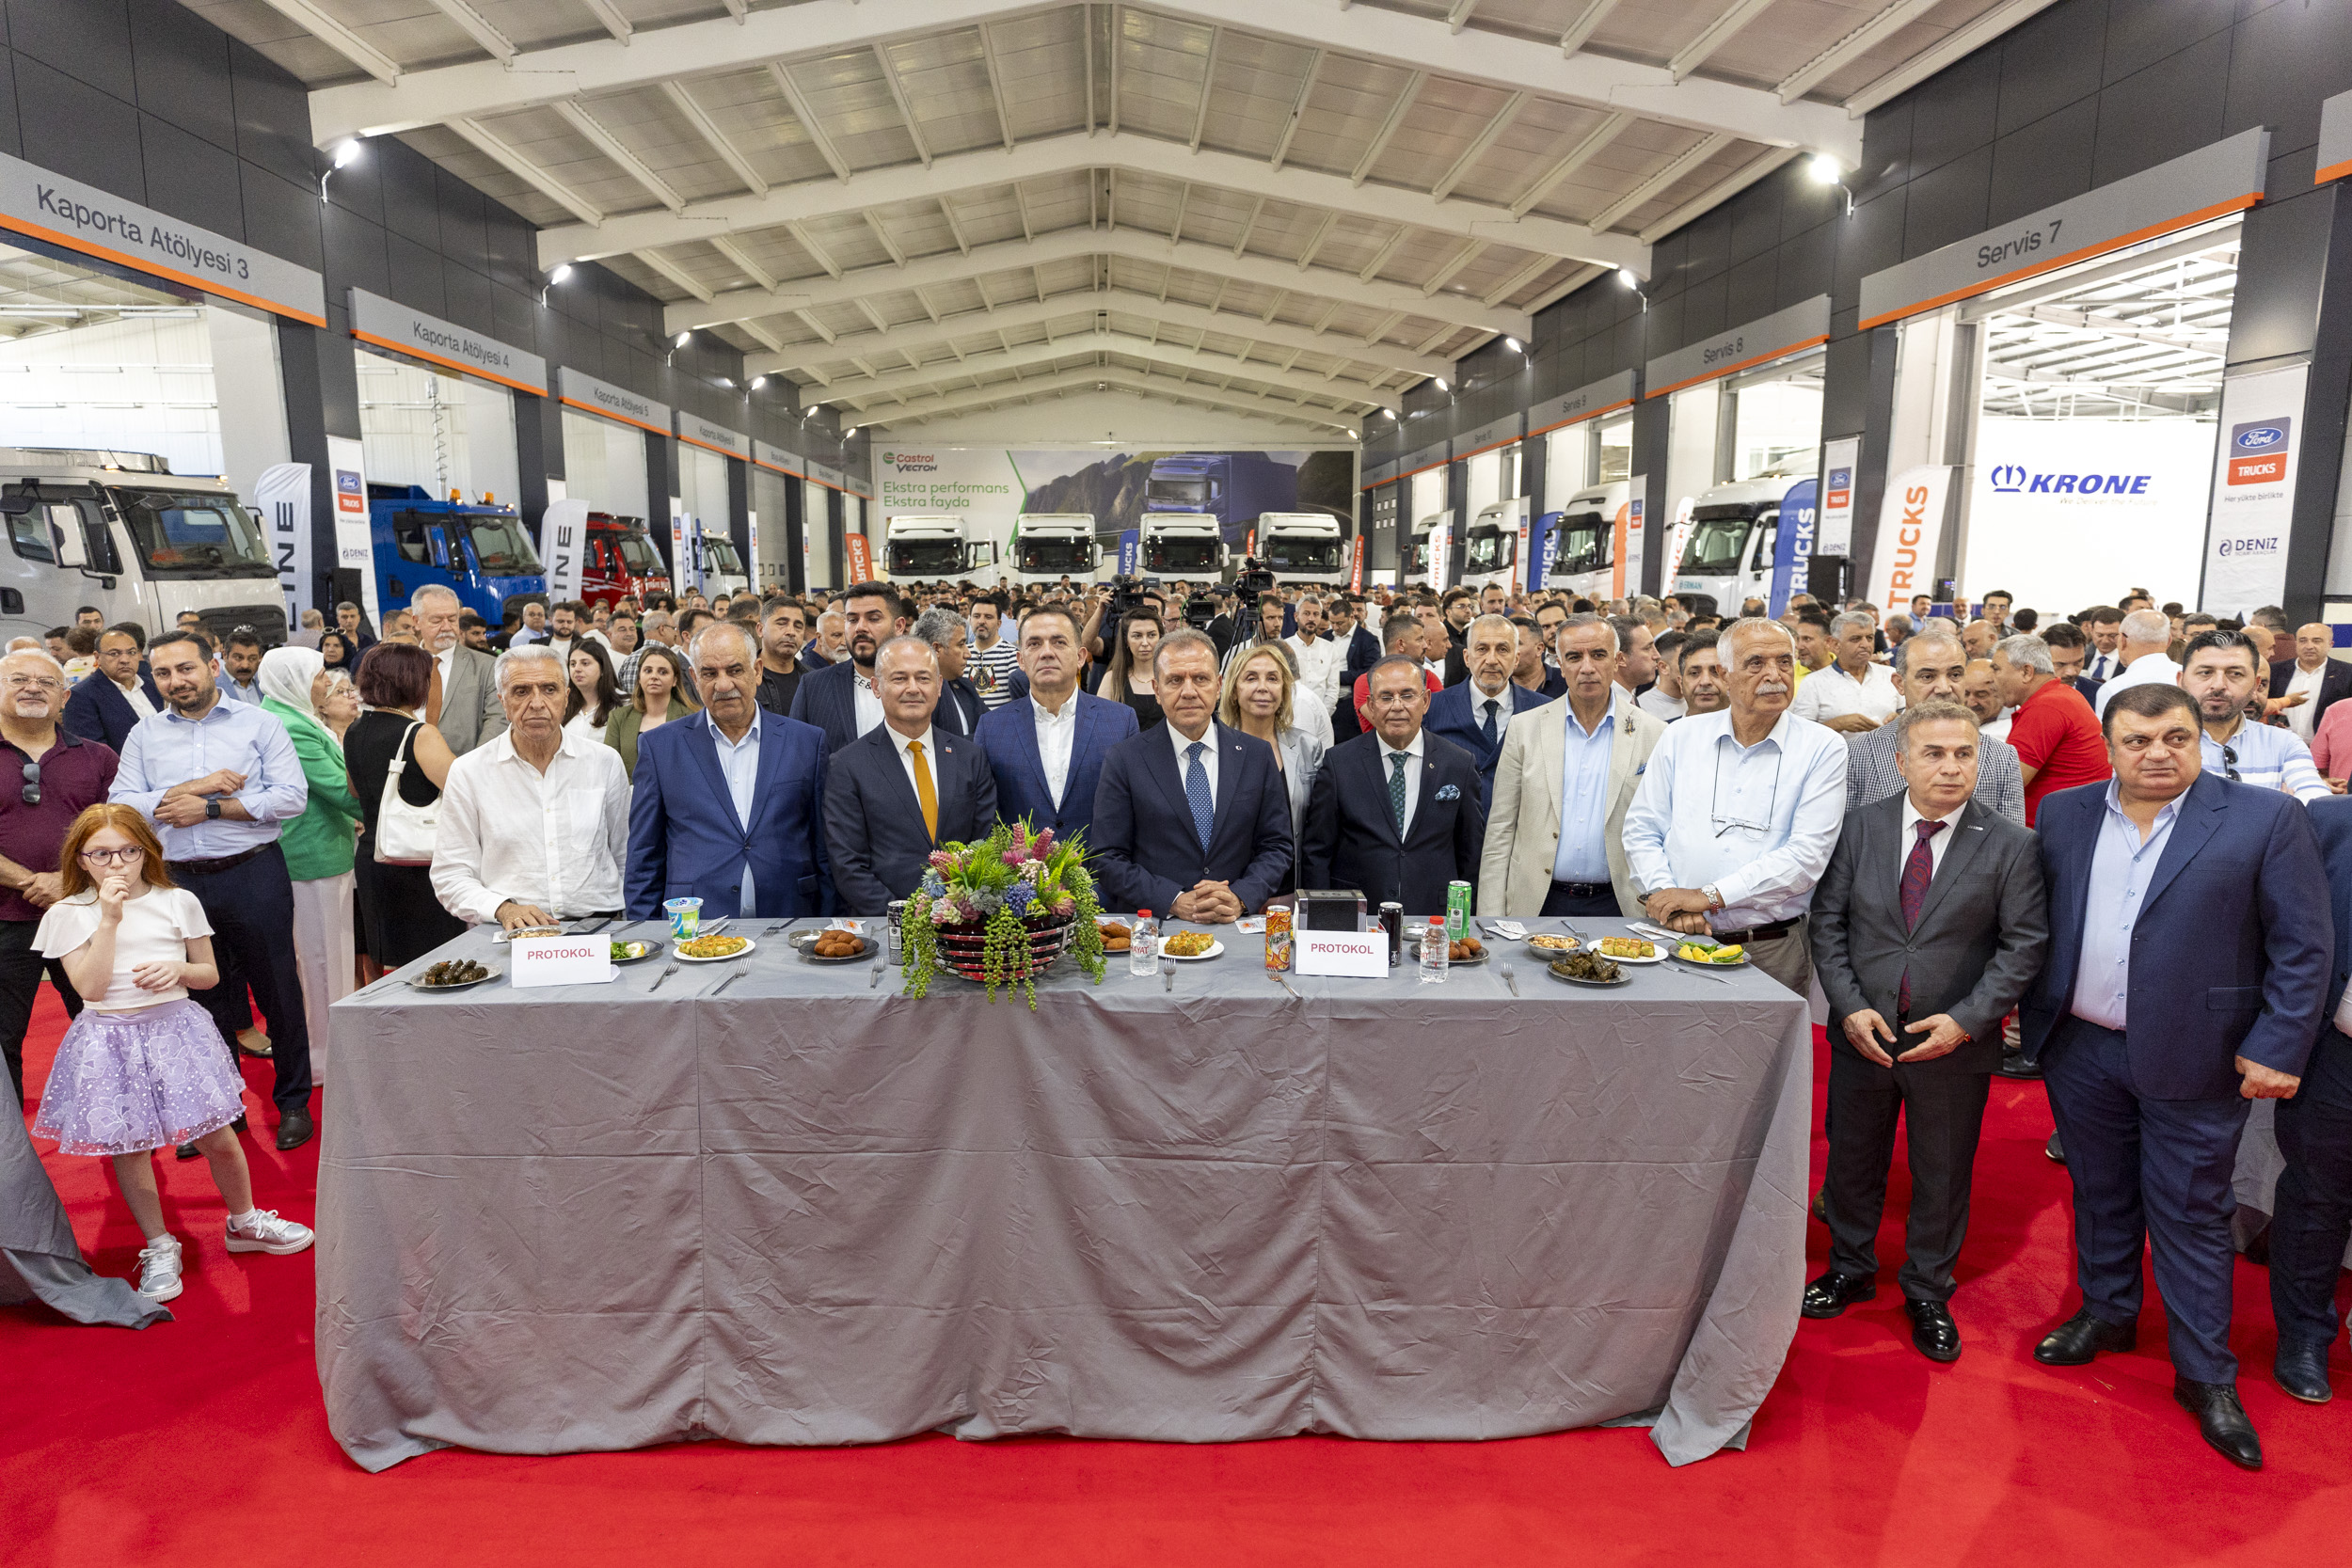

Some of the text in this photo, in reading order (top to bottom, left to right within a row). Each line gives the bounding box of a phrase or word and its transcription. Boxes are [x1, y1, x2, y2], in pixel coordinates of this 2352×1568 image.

[37, 183, 249, 280] Kaporta Atölyesi 3
[1977, 219, 2062, 268] Servis 7
[413, 321, 510, 368] Kaporta Atölyesi 4
[1704, 337, 1743, 364] Servis 8
[594, 387, 620, 407] Kaporta
[1563, 394, 1587, 414] Servis 9
[2245, 430, 2275, 446] Ford
[897, 453, 934, 463] Castrol
[2237, 463, 2277, 478] TRUCKS
[883, 481, 927, 494] Ekstra
[930, 481, 1009, 496] performans
[2028, 474, 2153, 495] KRONE
[342, 499, 360, 509] TRUCKS
[883, 496, 970, 511] Ekstra fayda
[1887, 485, 1929, 610] TRUCKS
[553, 525, 572, 602] INE
[528, 947, 595, 960] PROTOKOL
[1311, 942, 1374, 955] PROTOKOL
